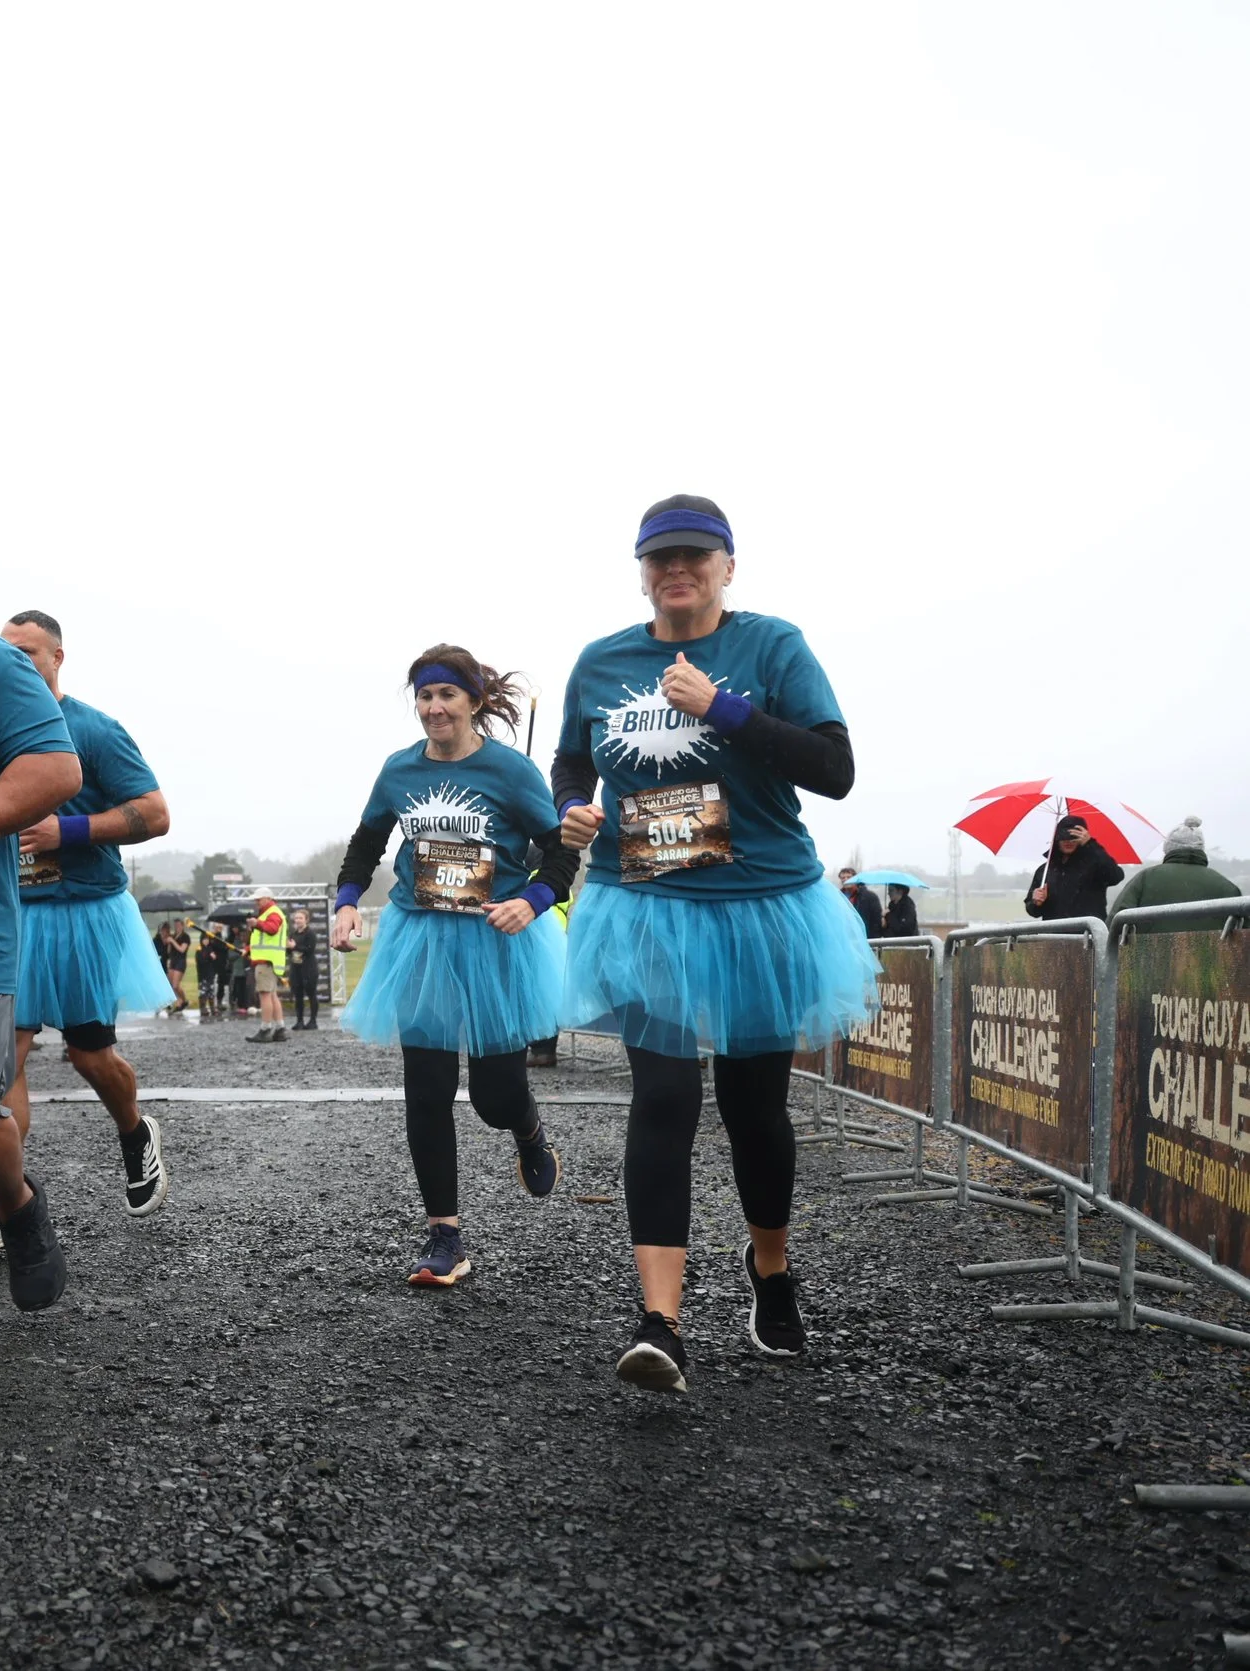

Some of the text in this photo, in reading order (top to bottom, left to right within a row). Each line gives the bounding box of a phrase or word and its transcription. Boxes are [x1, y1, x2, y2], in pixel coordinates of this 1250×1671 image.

[612, 713, 624, 733] TEAM
[622, 706, 704, 734] BRITOM
[410, 816, 480, 835] BRITOMUD
[648, 817, 693, 847] 504
[430, 848, 479, 860] CHALLENGE
[656, 847, 691, 862] SARAH
[435, 865, 468, 888] 503
[442, 889, 456, 898] DEE
[882, 983, 897, 1006] AND
[897, 984, 912, 1008] GAL
[971, 984, 1060, 1023] TOUGH GUY AND GAL
[1152, 993, 1200, 1044] TOUGH
[1202, 1000, 1238, 1050] GUY
[971, 1019, 1060, 1089] CHALLENGE
[1149, 1047, 1250, 1154] CHALLE
[1146, 1131, 1183, 1182] EXTREME
[1184, 1148, 1202, 1188] OFF
[1202, 1155, 1228, 1201] ROAD
